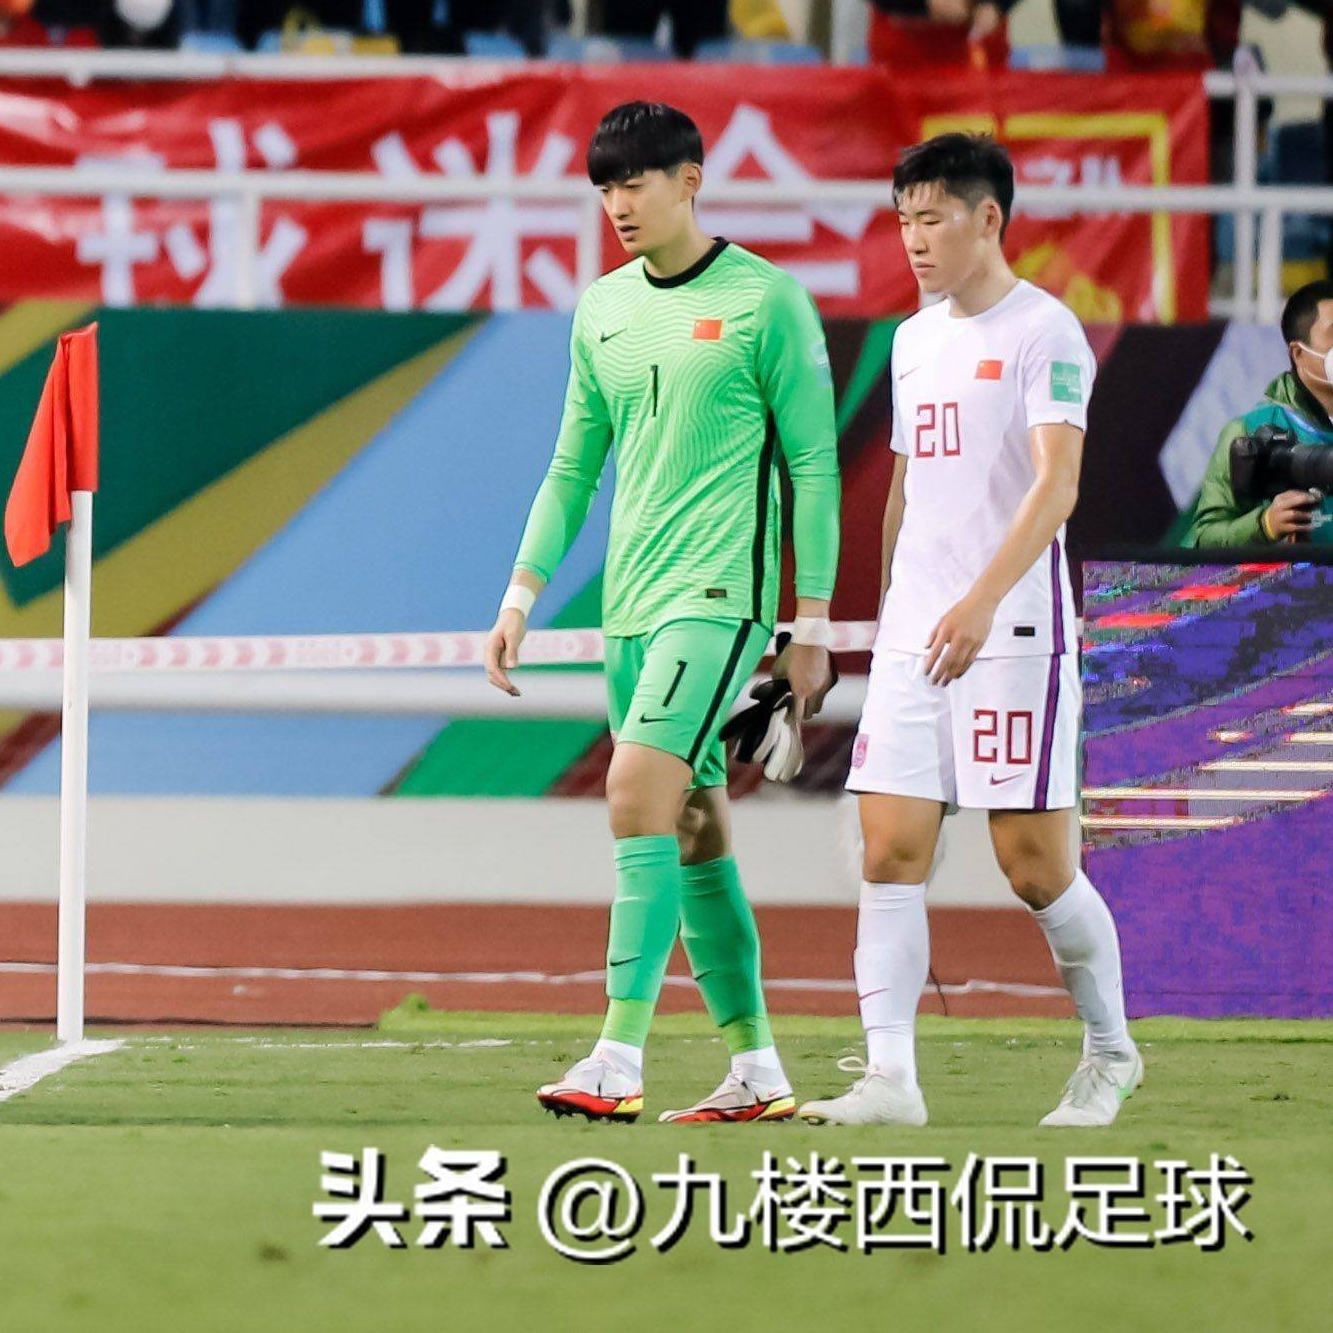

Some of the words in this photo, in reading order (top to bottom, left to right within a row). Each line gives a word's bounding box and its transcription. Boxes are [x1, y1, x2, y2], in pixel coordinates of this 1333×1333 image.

[648, 363, 661, 417] 1
[914, 400, 962, 459] 20
[662, 659, 688, 709] 1
[972, 708, 1033, 766] 20
